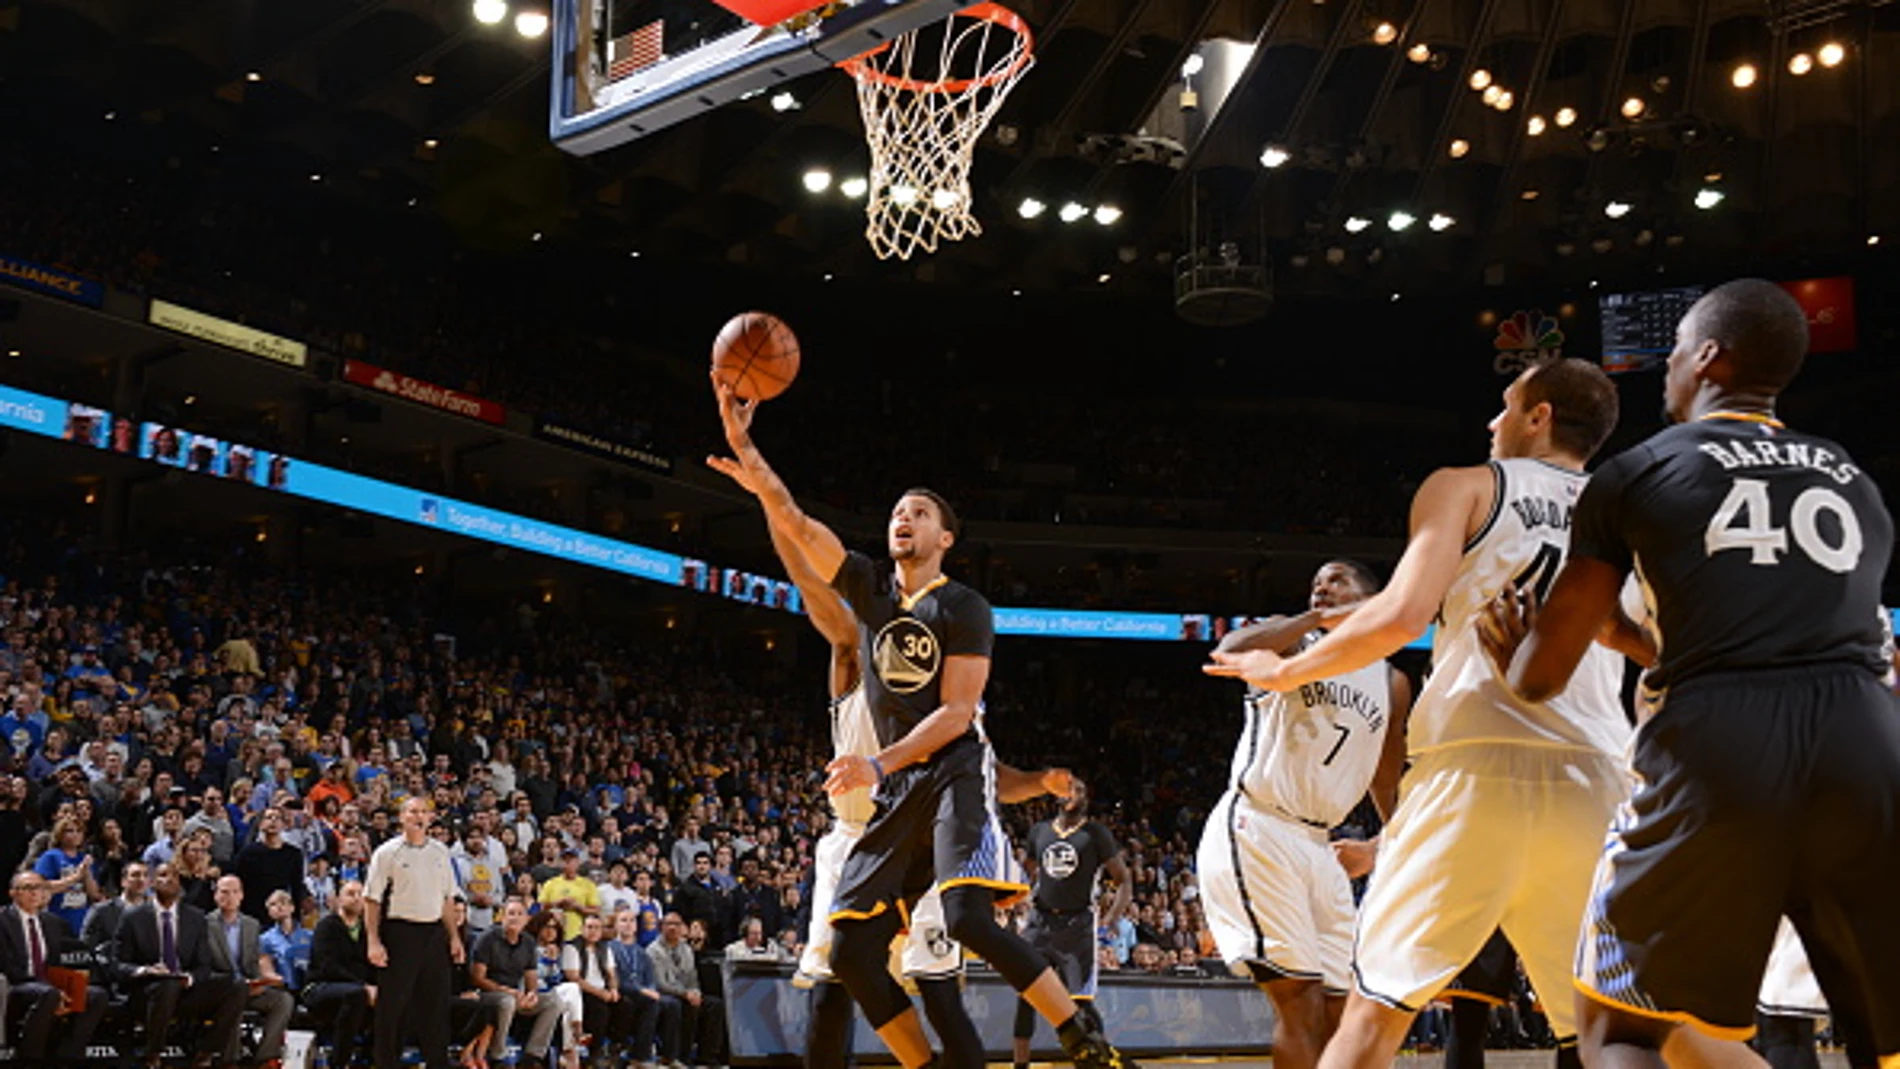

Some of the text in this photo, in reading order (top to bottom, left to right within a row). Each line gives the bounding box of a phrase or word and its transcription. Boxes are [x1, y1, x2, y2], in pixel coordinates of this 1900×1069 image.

[542, 423, 670, 469] AMERICAN EXPRESS
[1698, 439, 1861, 484] BARNES
[1705, 478, 1863, 573] 40
[510, 522, 562, 554] Building
[574, 538, 612, 561] Better
[613, 549, 670, 575] California
[903, 634, 932, 660] 30
[1060, 616, 1099, 631] Better
[1102, 617, 1167, 633] California
[1298, 680, 1385, 734] BROOKLYN
[1322, 721, 1350, 766] 7
